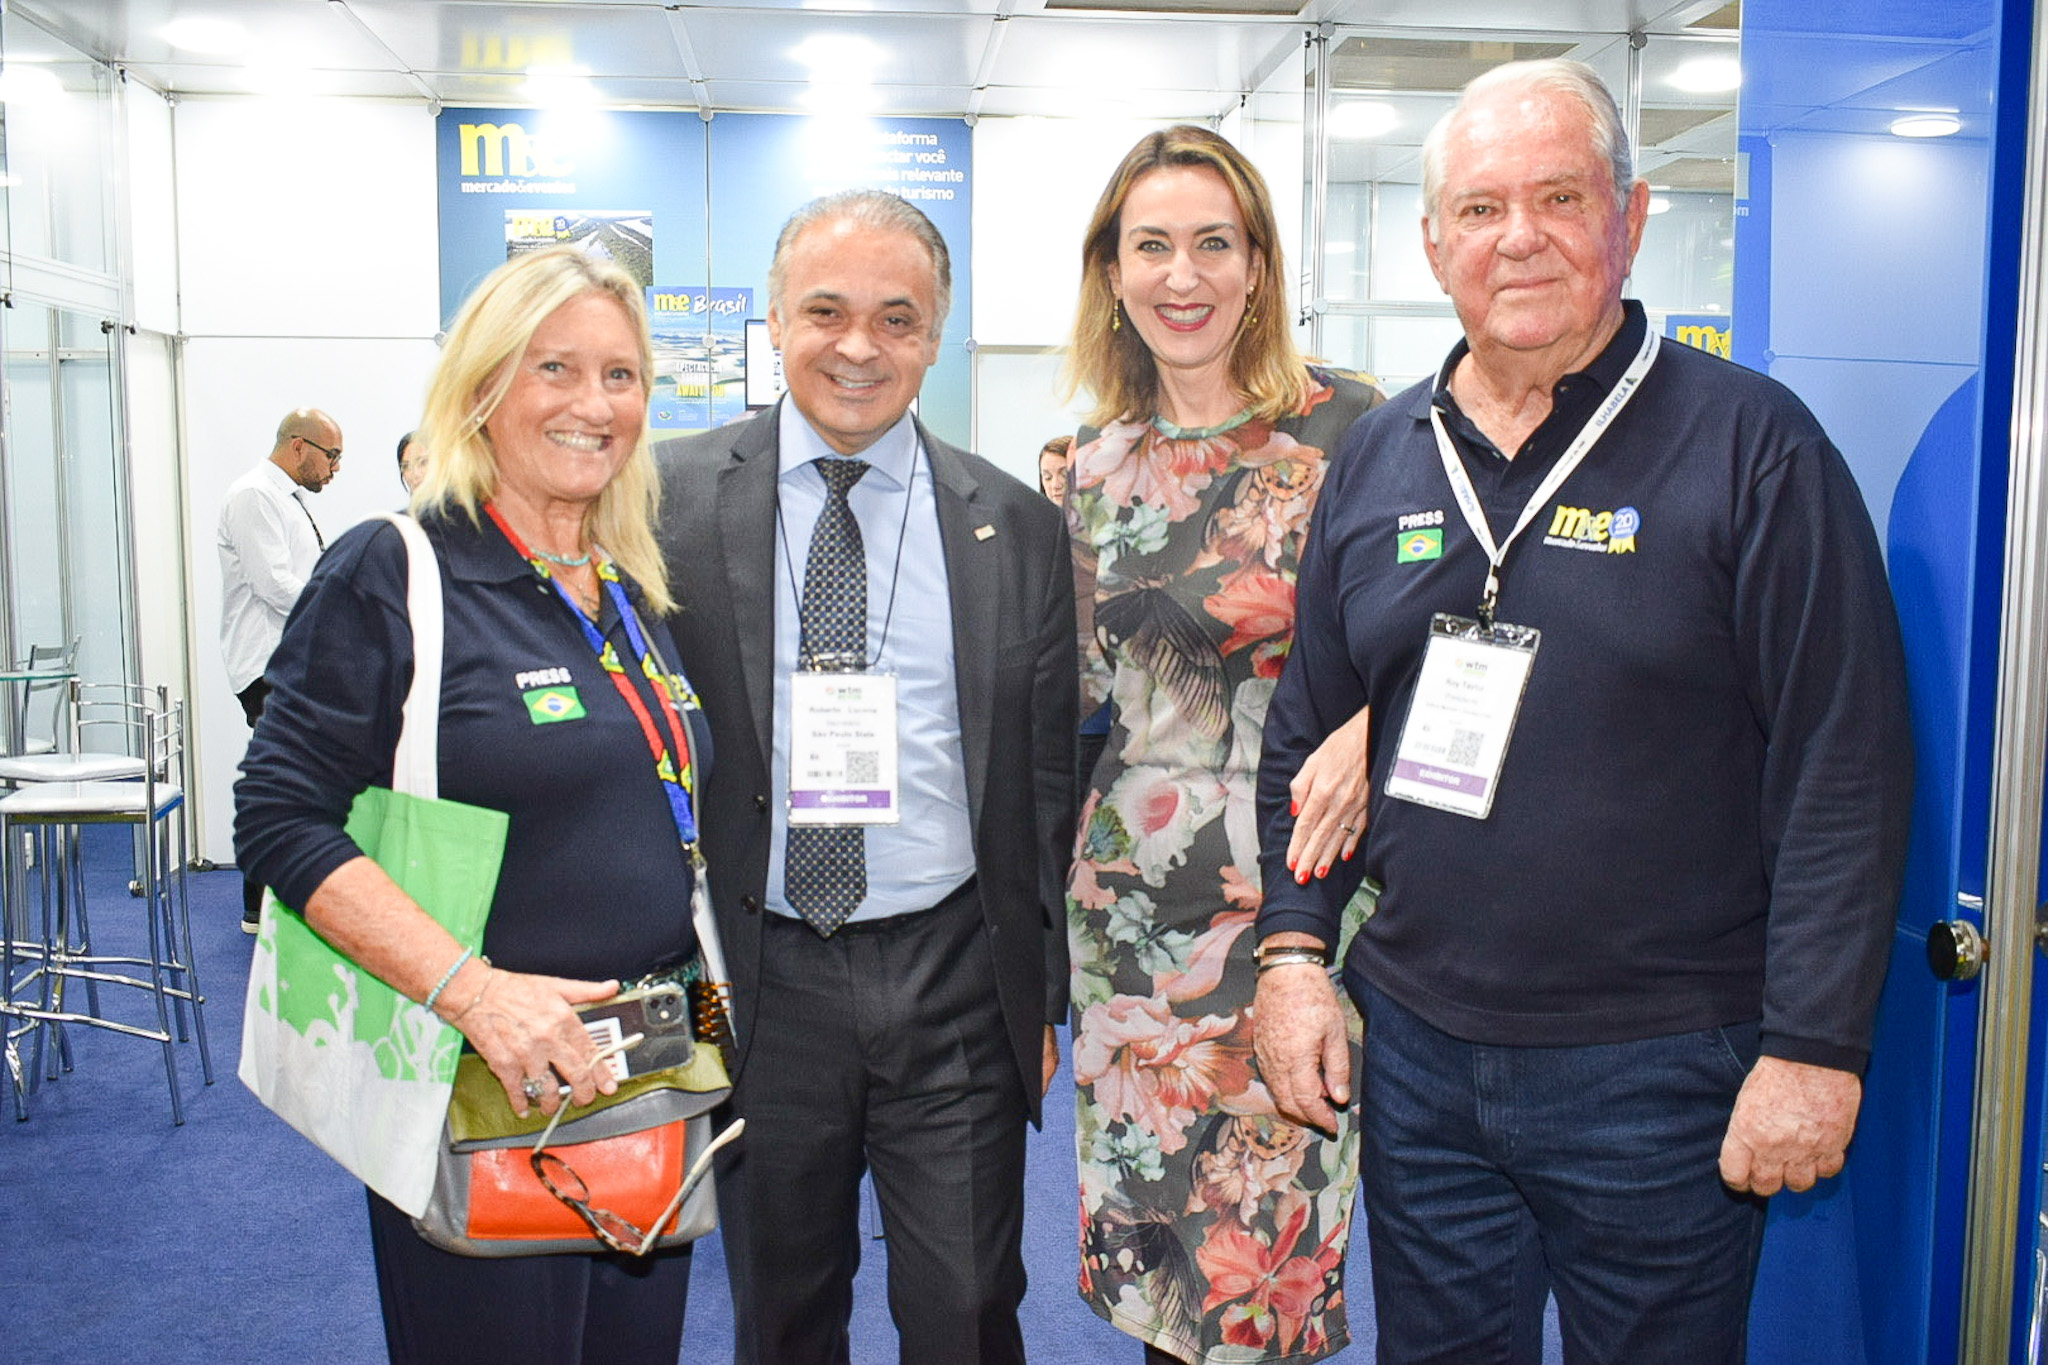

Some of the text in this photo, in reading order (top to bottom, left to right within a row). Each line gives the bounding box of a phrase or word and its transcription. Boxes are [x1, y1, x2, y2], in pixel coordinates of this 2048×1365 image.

[915, 149, 947, 164] você
[901, 168, 965, 182] relevante
[901, 186, 955, 200] turismo
[693, 293, 748, 316] Brasil
[1398, 510, 1445, 531] PRESS
[1615, 512, 1633, 529] 20
[515, 667, 572, 690] PRESS
